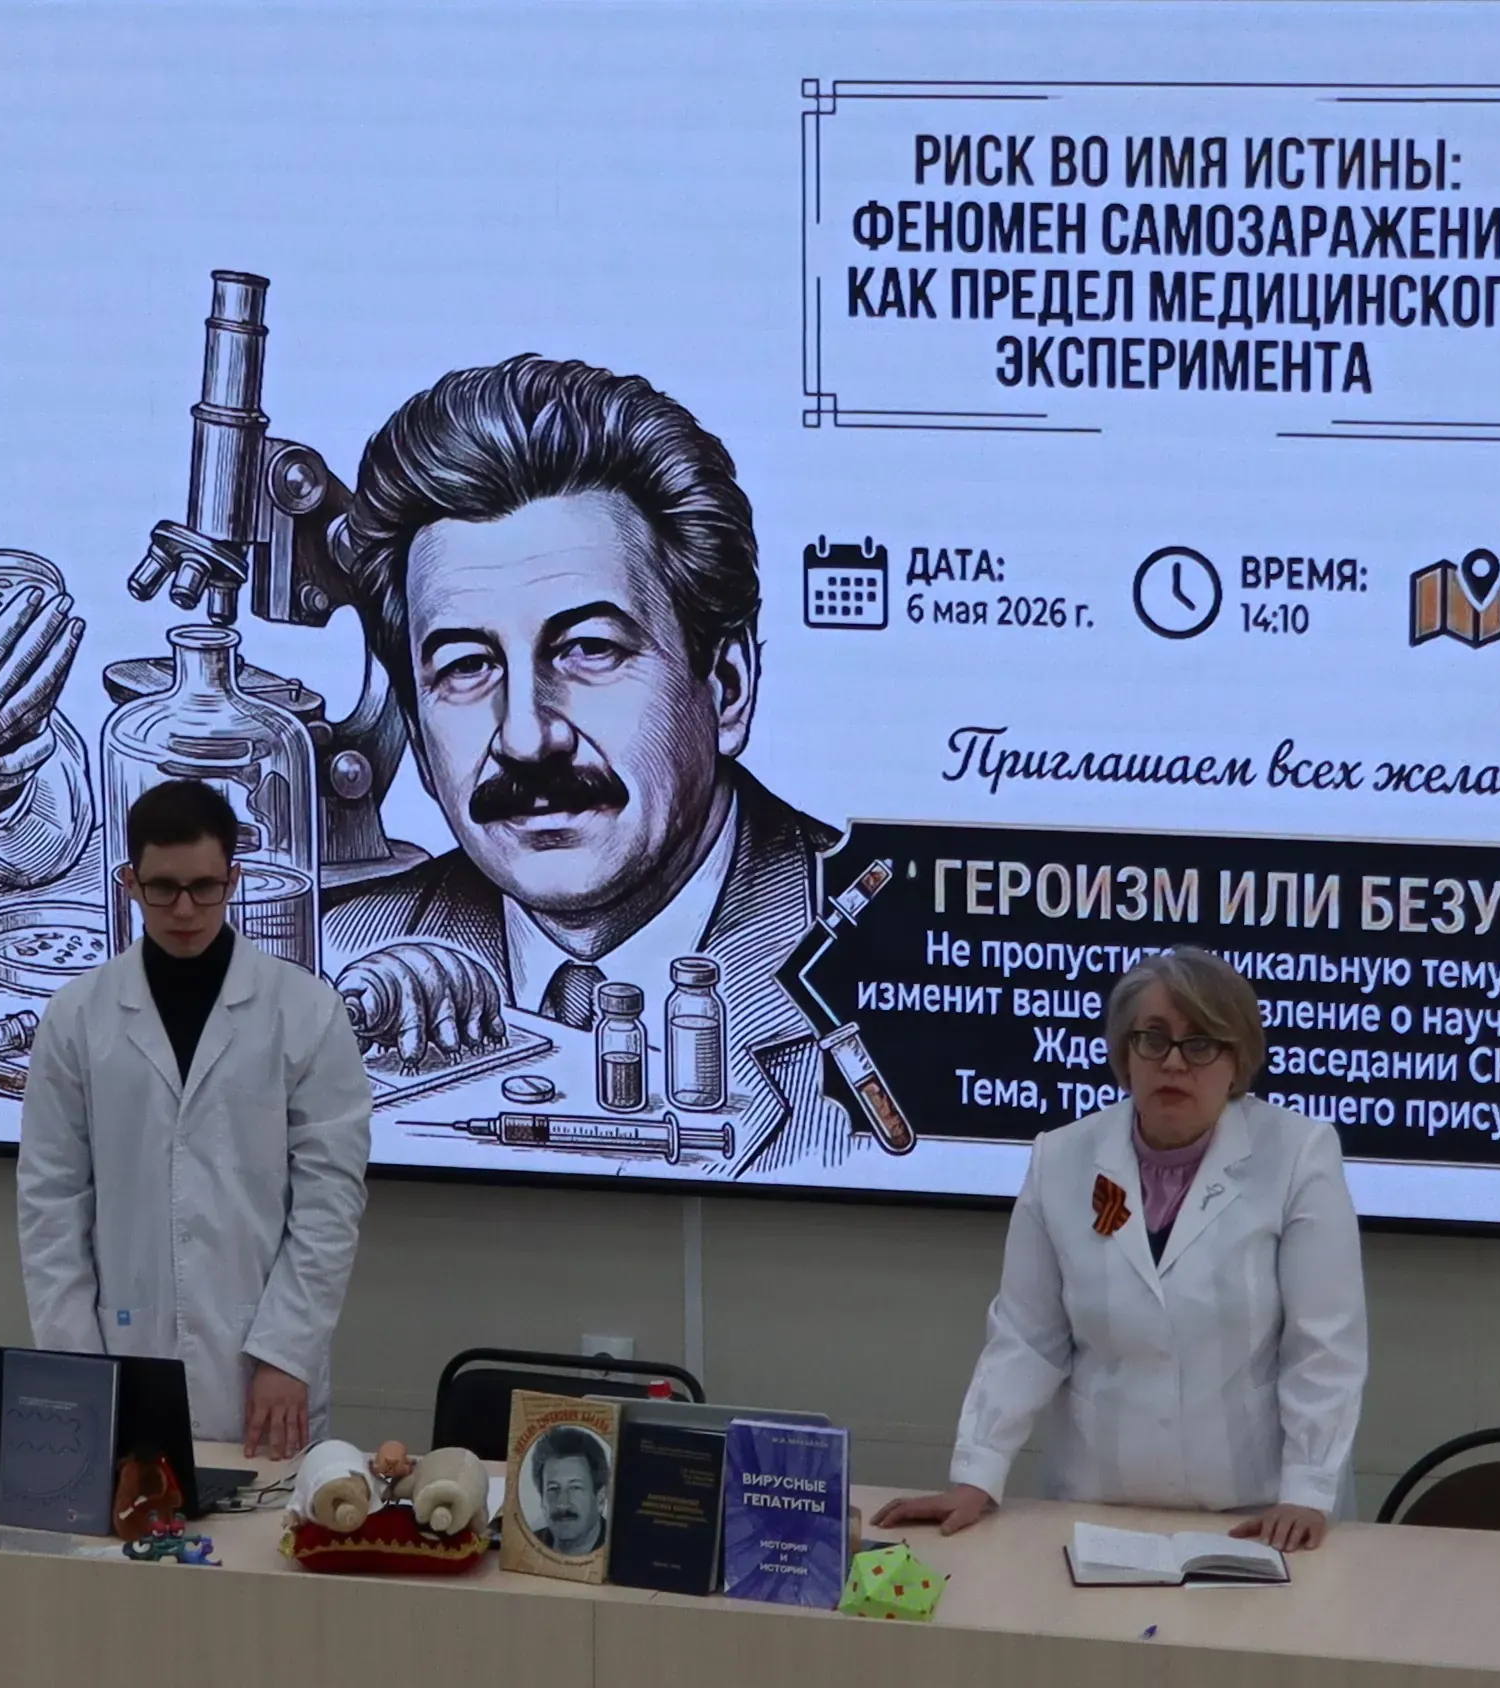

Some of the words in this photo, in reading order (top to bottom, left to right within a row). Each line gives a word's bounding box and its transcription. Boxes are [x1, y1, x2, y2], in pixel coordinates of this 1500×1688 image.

[915, 134, 1036, 187] РИСК
[1051, 135, 1109, 188] ВО
[1125, 135, 1227, 189] ИМЯ
[1244, 136, 1461, 191] ИСТИНЫ:
[852, 199, 1086, 254] ФЕНОМЕН
[848, 266, 937, 319] КАК
[951, 268, 1134, 327] ПРЕДЕЛ
[996, 335, 1372, 394] ЭКСПЕРИМЕНТА
[906, 546, 1005, 587] ДАТА:
[1241, 555, 1368, 592] ВРЕМЯ:
[906, 593, 924, 624] 6
[933, 600, 988, 625] мая
[997, 595, 1067, 628] 2026
[1075, 604, 1094, 628] г.
[1240, 602, 1309, 635] 14:10
[942, 726, 1257, 795] Приглашаем
[1266, 738, 1365, 790] всех
[934, 858, 1199, 924] ГЕРОИЗМ
[1219, 870, 1340, 929] ИЛИ
[926, 930, 971, 967] Не
[981, 940, 1175, 979] пропусти
[1204, 950, 1410, 994] икальную
[857, 981, 1003, 1015] изменит
[1012, 988, 1102, 1019] ваше
[1391, 1005, 1412, 1034] о
[1033, 1026, 1108, 1069] Жде
[1268, 1045, 1458, 1084] заседании
[955, 1068, 1047, 1115] Тема,
[742, 1472, 827, 1493] ВИРУСНЫЕ
[743, 1492, 825, 1513] ГЕПАТИТЫ
[759, 1539, 808, 1553] ИСТОРИЯ
[779, 1554, 788, 1562] И
[759, 1562, 808, 1576] ИСТОРИИ
